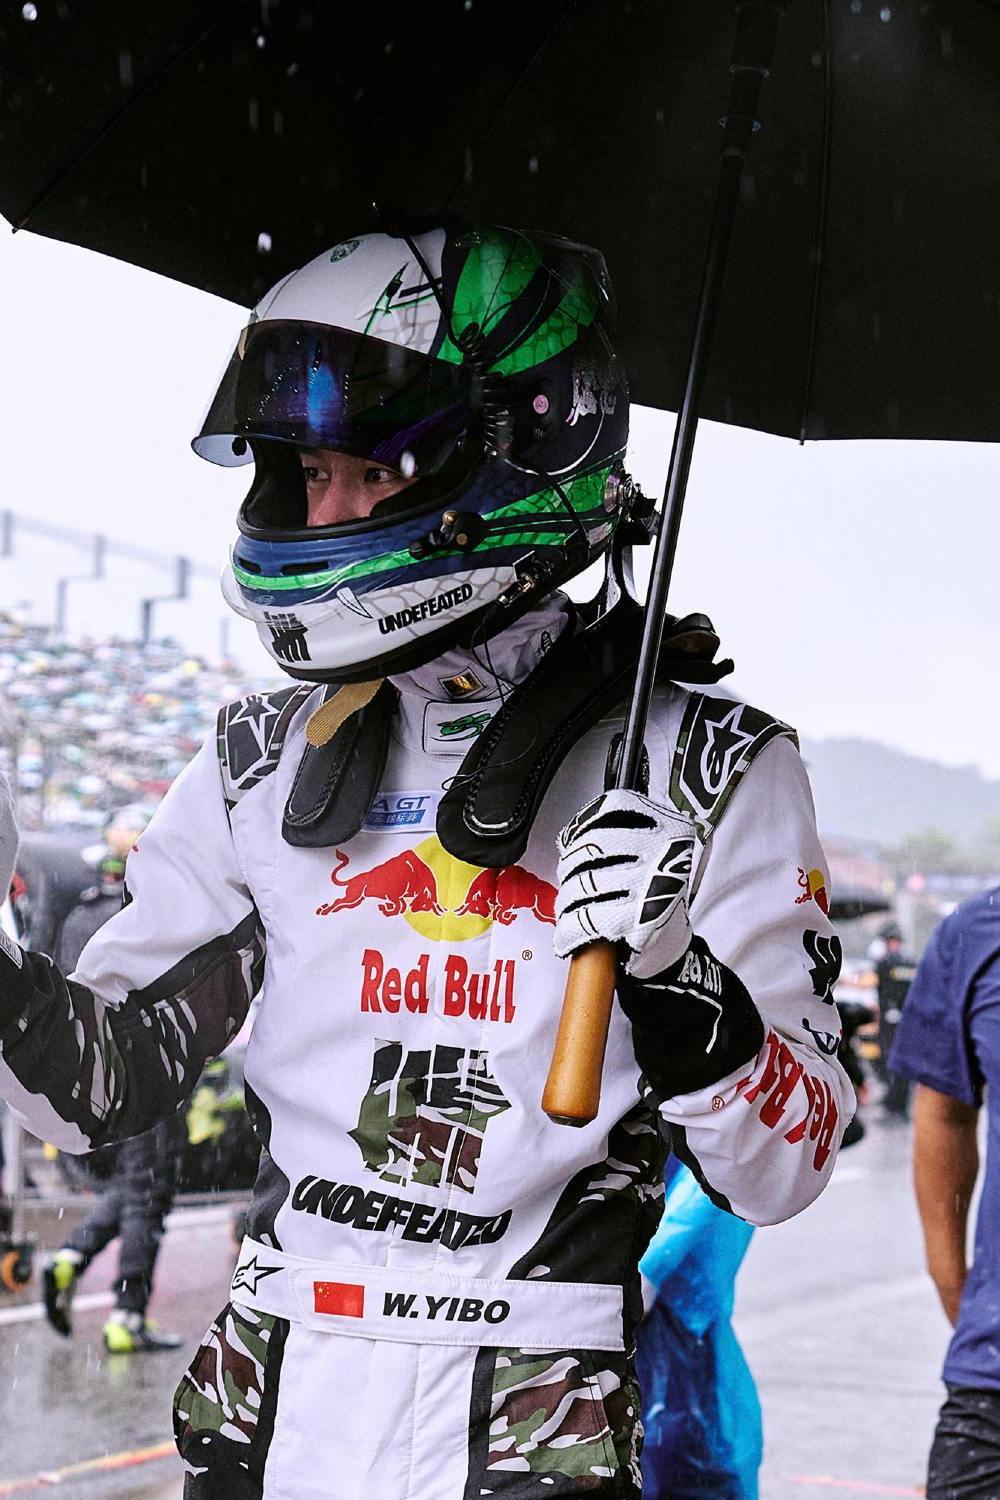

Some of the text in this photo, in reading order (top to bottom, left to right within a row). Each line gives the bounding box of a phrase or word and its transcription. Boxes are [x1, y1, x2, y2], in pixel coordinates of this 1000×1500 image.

[378, 583, 473, 635] UNDEFEATED
[397, 796, 431, 810] GT
[361, 949, 518, 1024] Red Bull
[382, 1292, 511, 1325] W.YIBO
